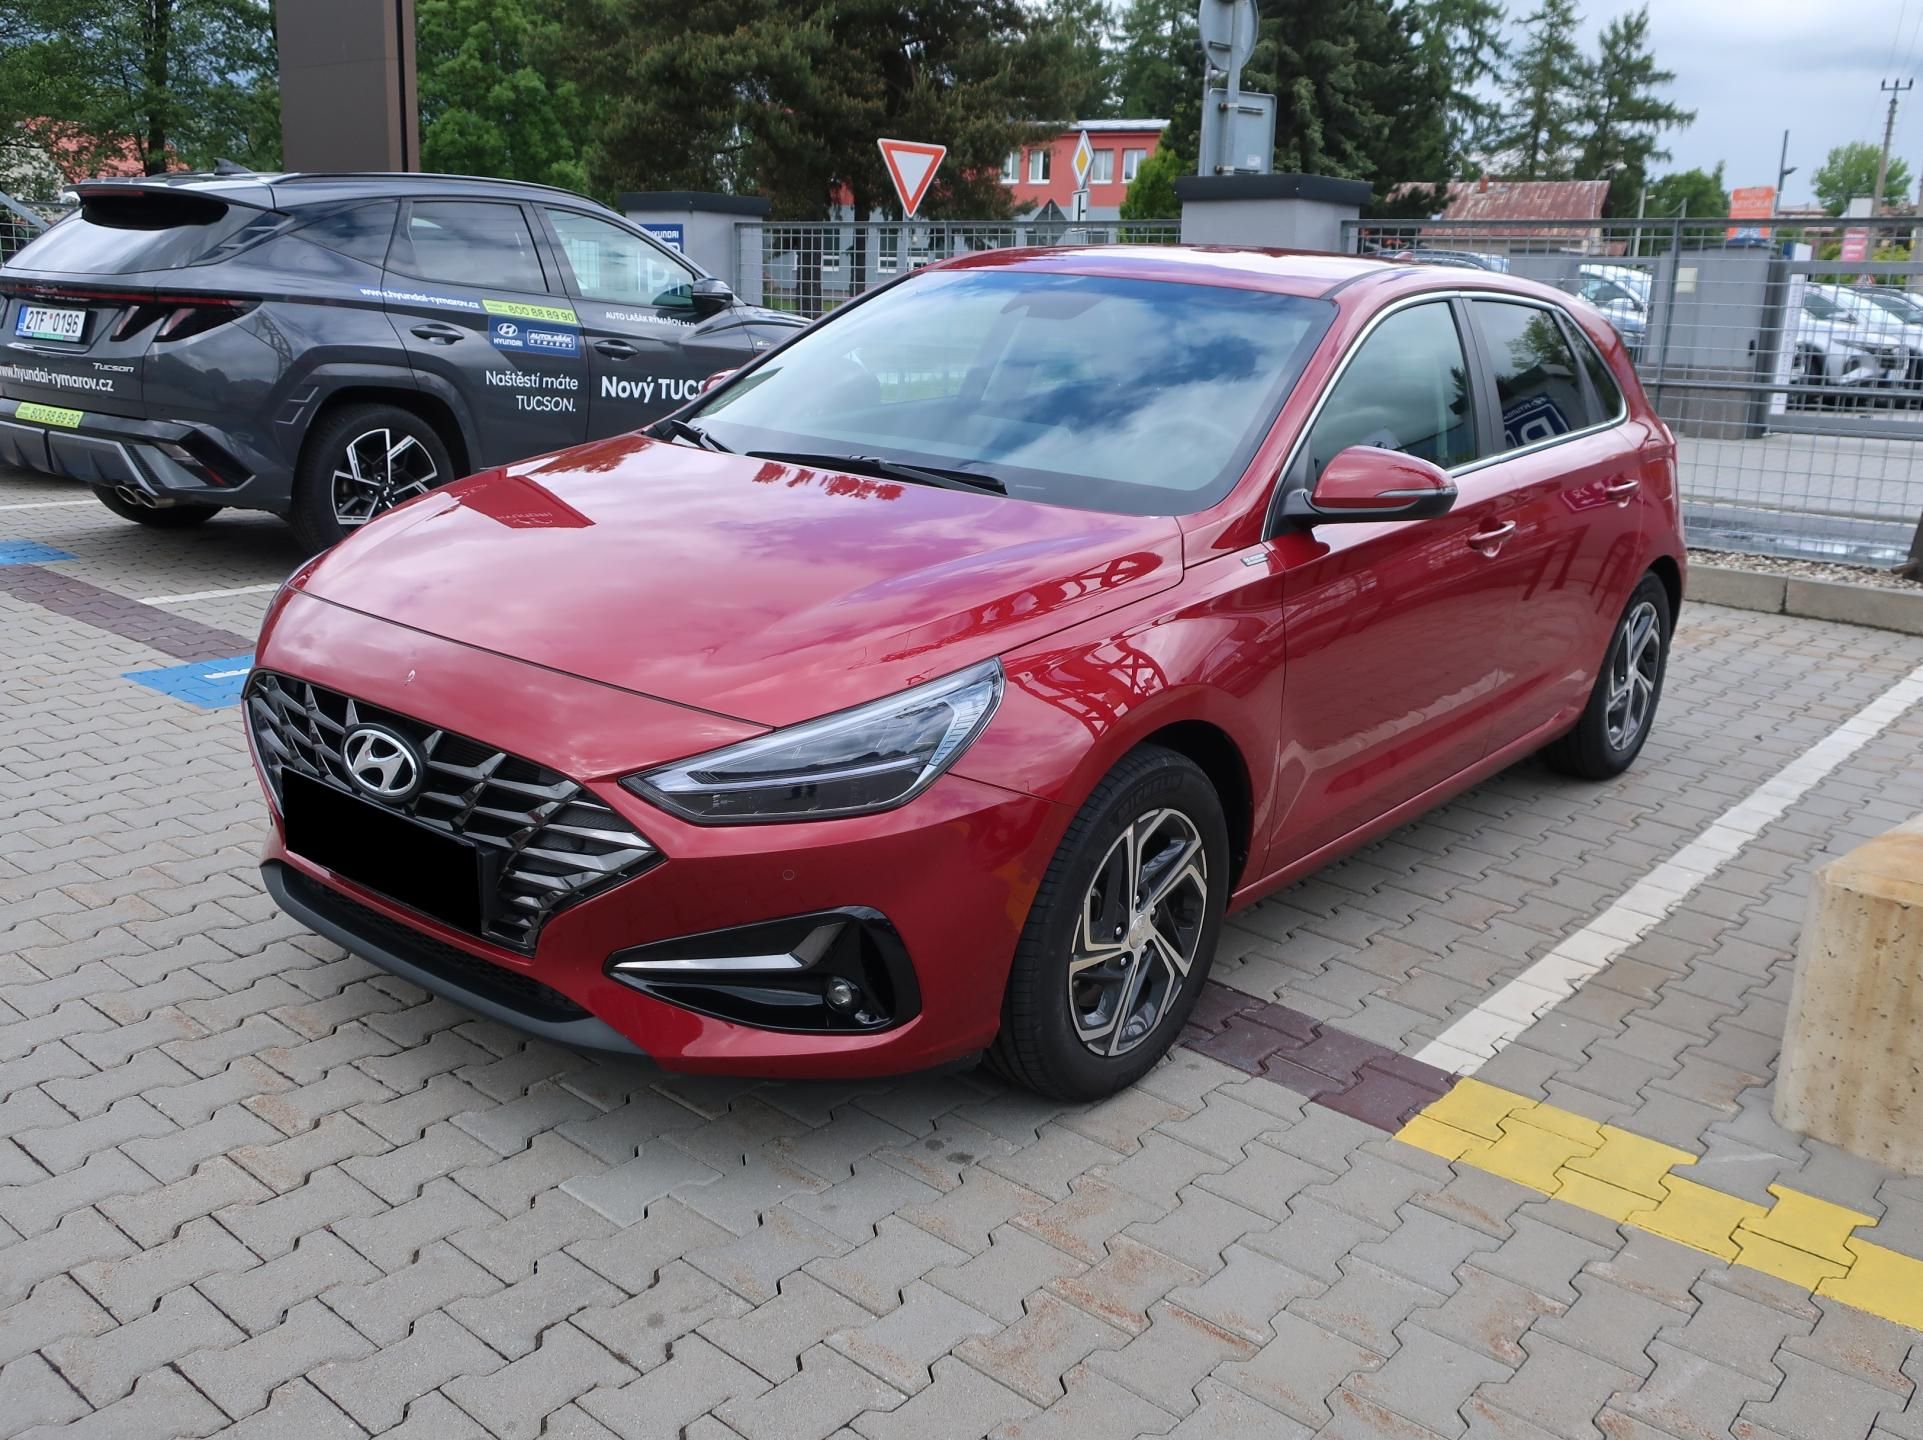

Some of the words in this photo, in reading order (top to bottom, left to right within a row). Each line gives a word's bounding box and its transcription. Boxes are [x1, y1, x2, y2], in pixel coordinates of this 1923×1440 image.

[26, 310, 47, 331] 2TF
[52, 313, 79, 334] 0196
[605, 312, 625, 320] AUTO
[493, 338, 523, 347] HYUNDAI
[485, 370, 540, 387] Naštěstí
[542, 372, 579, 390] máte
[601, 375, 655, 403] Nový
[515, 394, 577, 412] TUCSON.
